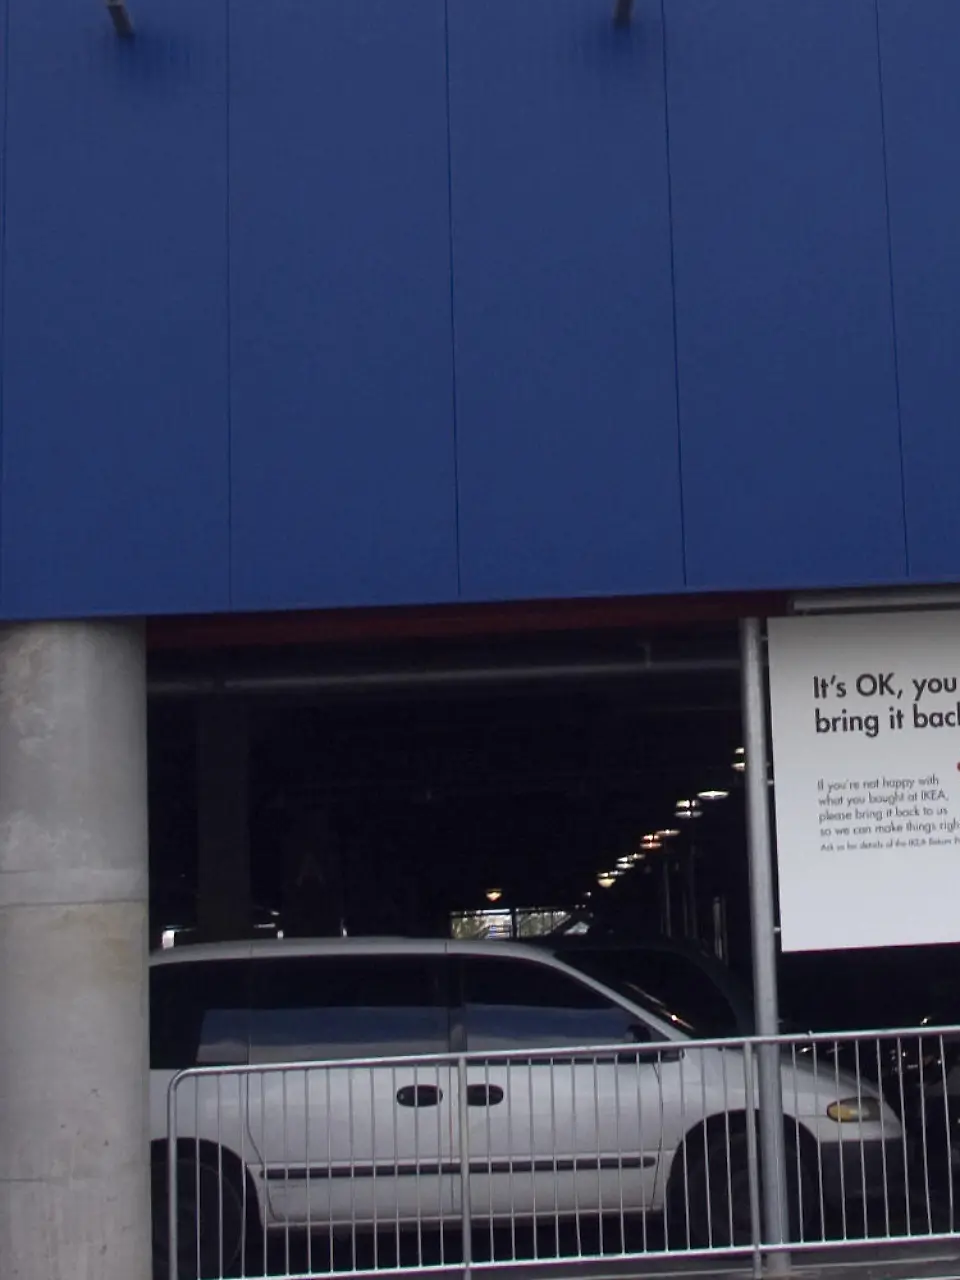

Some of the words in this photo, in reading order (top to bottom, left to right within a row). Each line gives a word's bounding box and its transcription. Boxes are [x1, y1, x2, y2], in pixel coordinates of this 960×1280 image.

[813, 675, 847, 699] It's
[855, 672, 903, 700] OK,
[911, 677, 958, 702] you
[814, 707, 879, 738] bring
[889, 706, 904, 730] it
[817, 778, 824, 791] If
[827, 779, 860, 794] you're
[863, 778, 879, 789] not
[882, 776, 915, 790] happy
[918, 773, 940, 786] with
[818, 793, 843, 806] what
[846, 795, 866, 807] you
[868, 791, 904, 806] bought
[907, 791, 918, 801] at
[818, 809, 852, 825] please
[855, 807, 883, 821] bring
[886, 807, 892, 818] it
[895, 804, 920, 817] back
[923, 805, 934, 816] to
[936, 806, 948, 816] us
[819, 826, 832, 837] so
[834, 826, 850, 836] we
[853, 825, 872, 835] can
[875, 821, 903, 834] make
[906, 819, 936, 834] things
